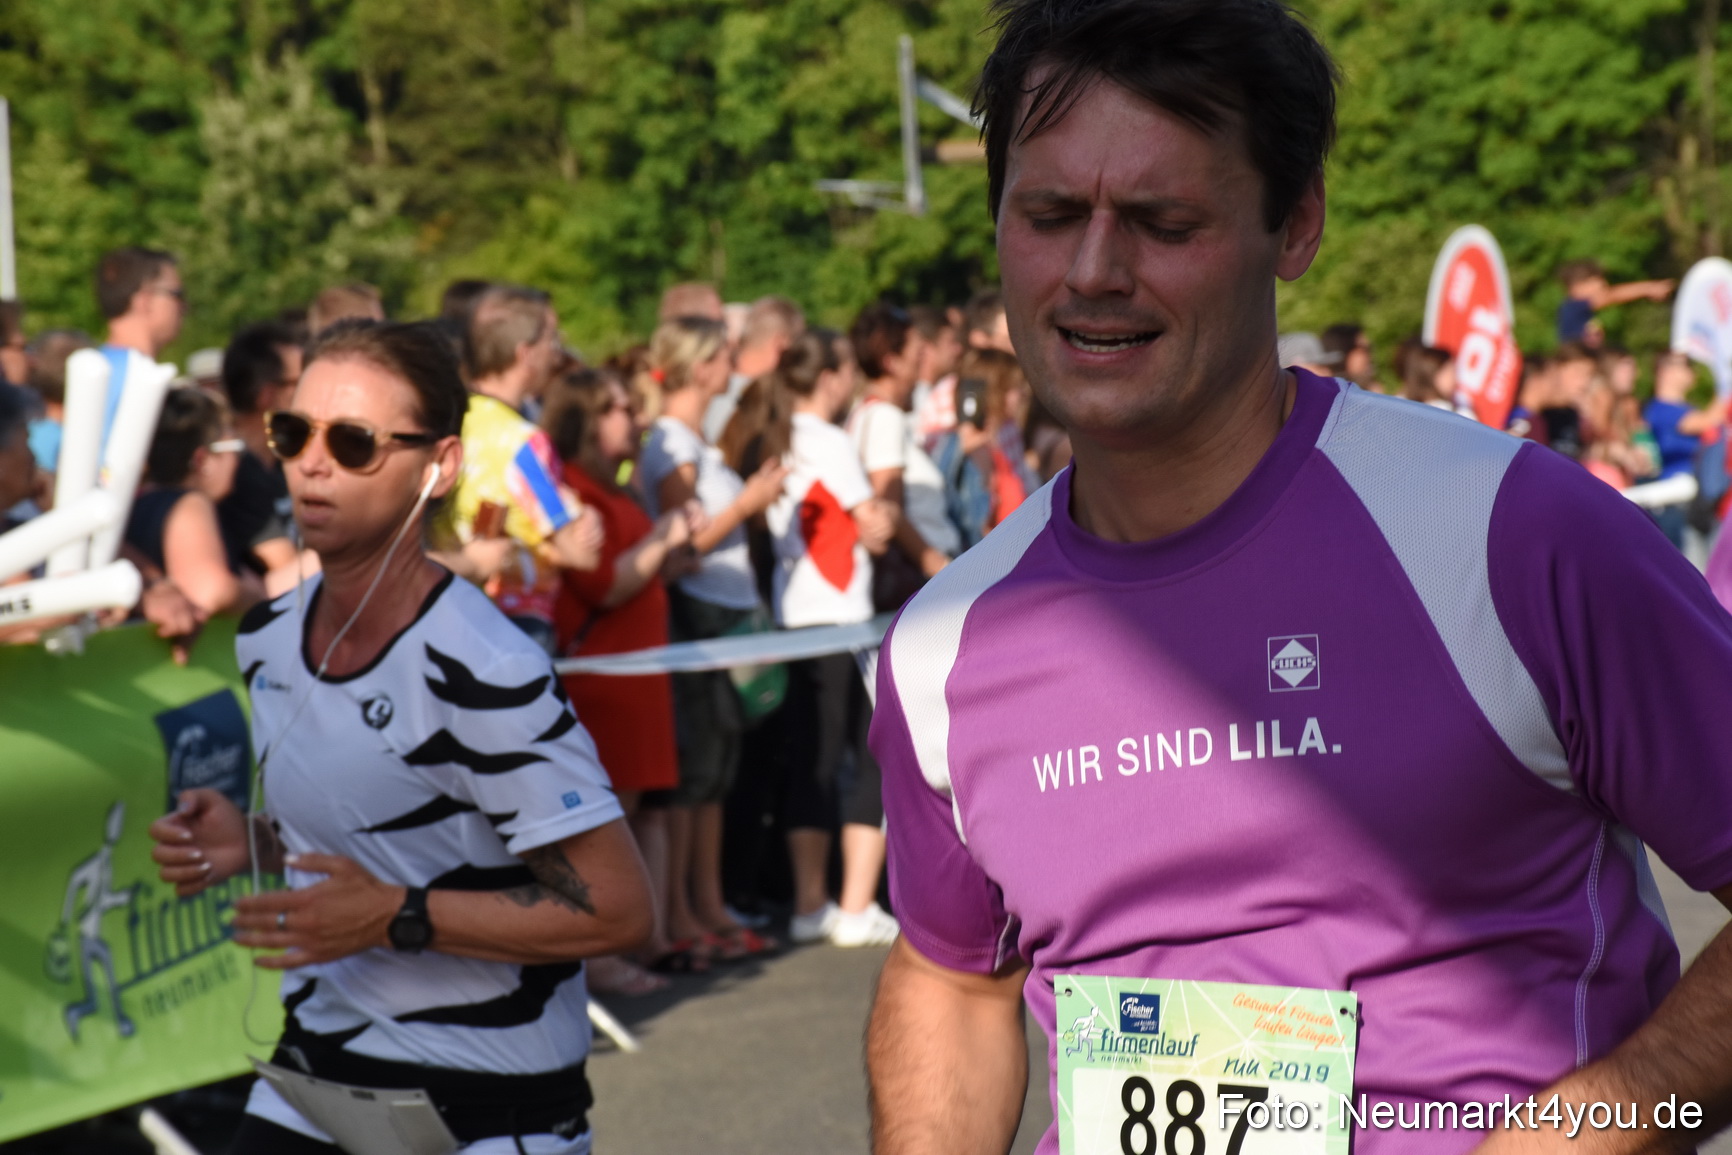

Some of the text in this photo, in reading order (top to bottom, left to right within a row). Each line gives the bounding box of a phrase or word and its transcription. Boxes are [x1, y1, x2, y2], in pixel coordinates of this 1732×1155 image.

[1271, 656, 1316, 670] FUCHS
[1032, 717, 1342, 792] WIR SIND LILA.
[1101, 1028, 1200, 1058] firmenlauf
[1268, 1061, 1330, 1083] 2019
[1120, 1075, 1269, 1155] 887
